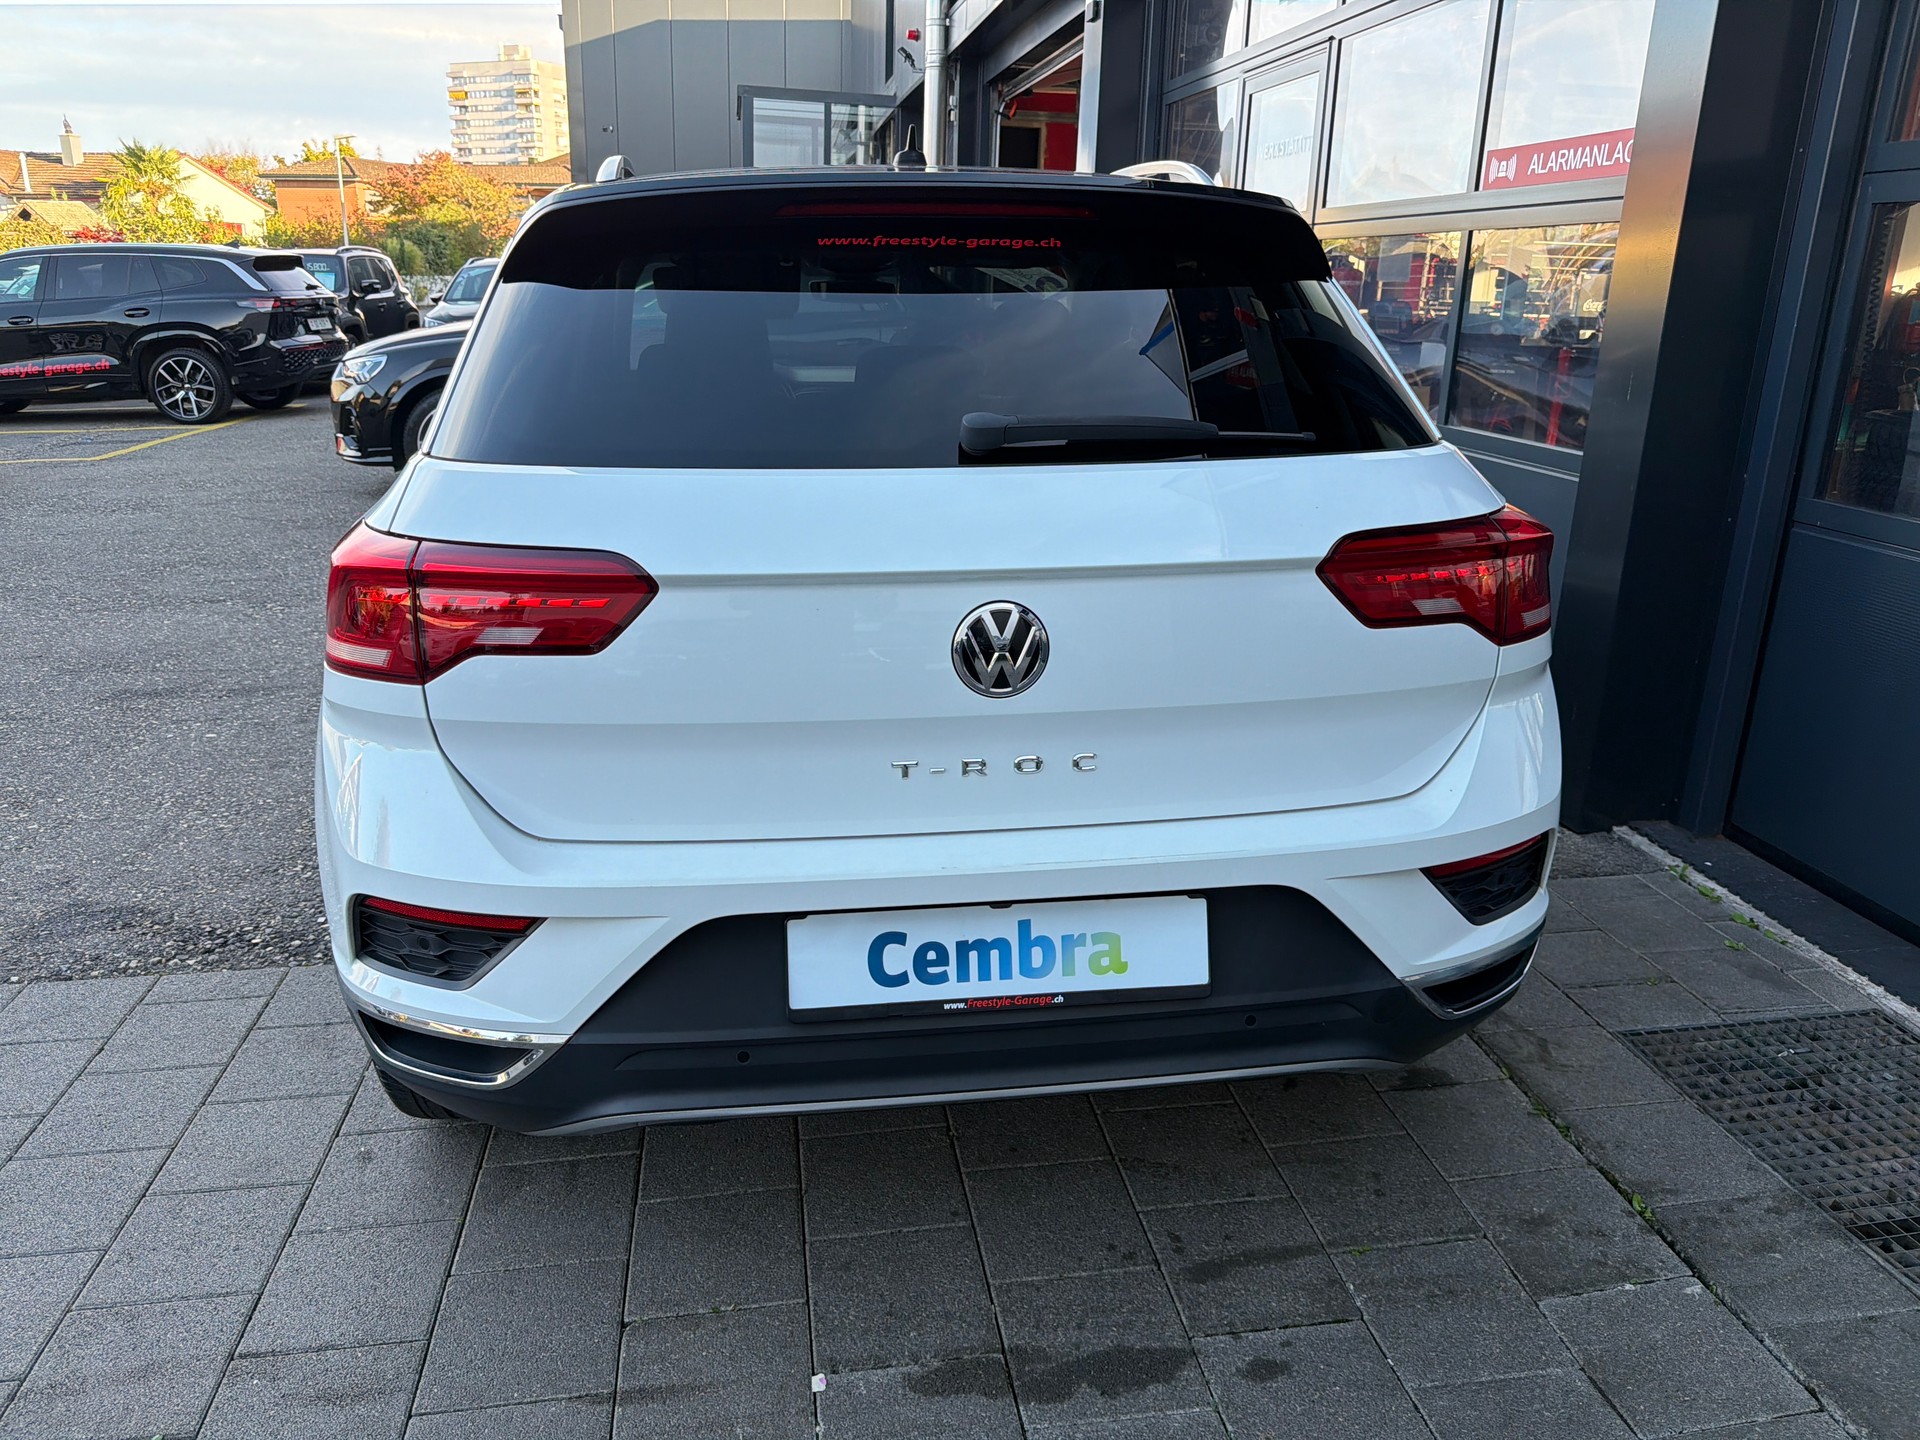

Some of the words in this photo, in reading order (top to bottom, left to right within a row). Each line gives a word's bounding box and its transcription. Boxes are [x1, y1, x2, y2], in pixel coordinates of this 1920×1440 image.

[817, 236, 1062, 249] www.freestyle-garage.ch
[891, 753, 1098, 781] T-ROC
[867, 918, 1129, 988] Cembra
[943, 994, 1064, 1010] www.Freestyle-Garage.ch
